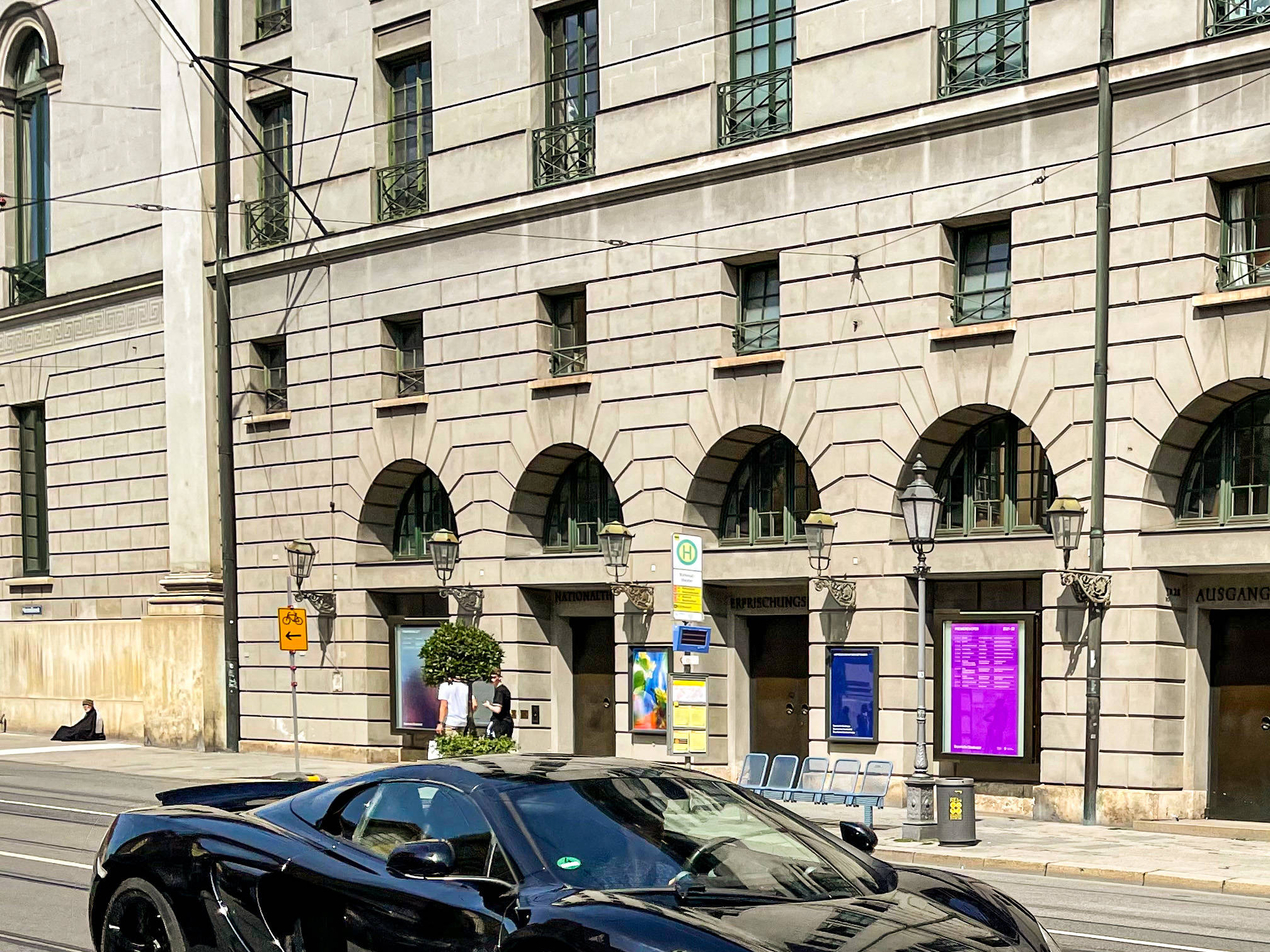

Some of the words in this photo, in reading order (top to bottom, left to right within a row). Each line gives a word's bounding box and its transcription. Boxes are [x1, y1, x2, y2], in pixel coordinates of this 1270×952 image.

[683, 545, 692, 560] H
[730, 596, 807, 609] ERFRISCHUNGS
[1196, 587, 1270, 603] AUSGANG
